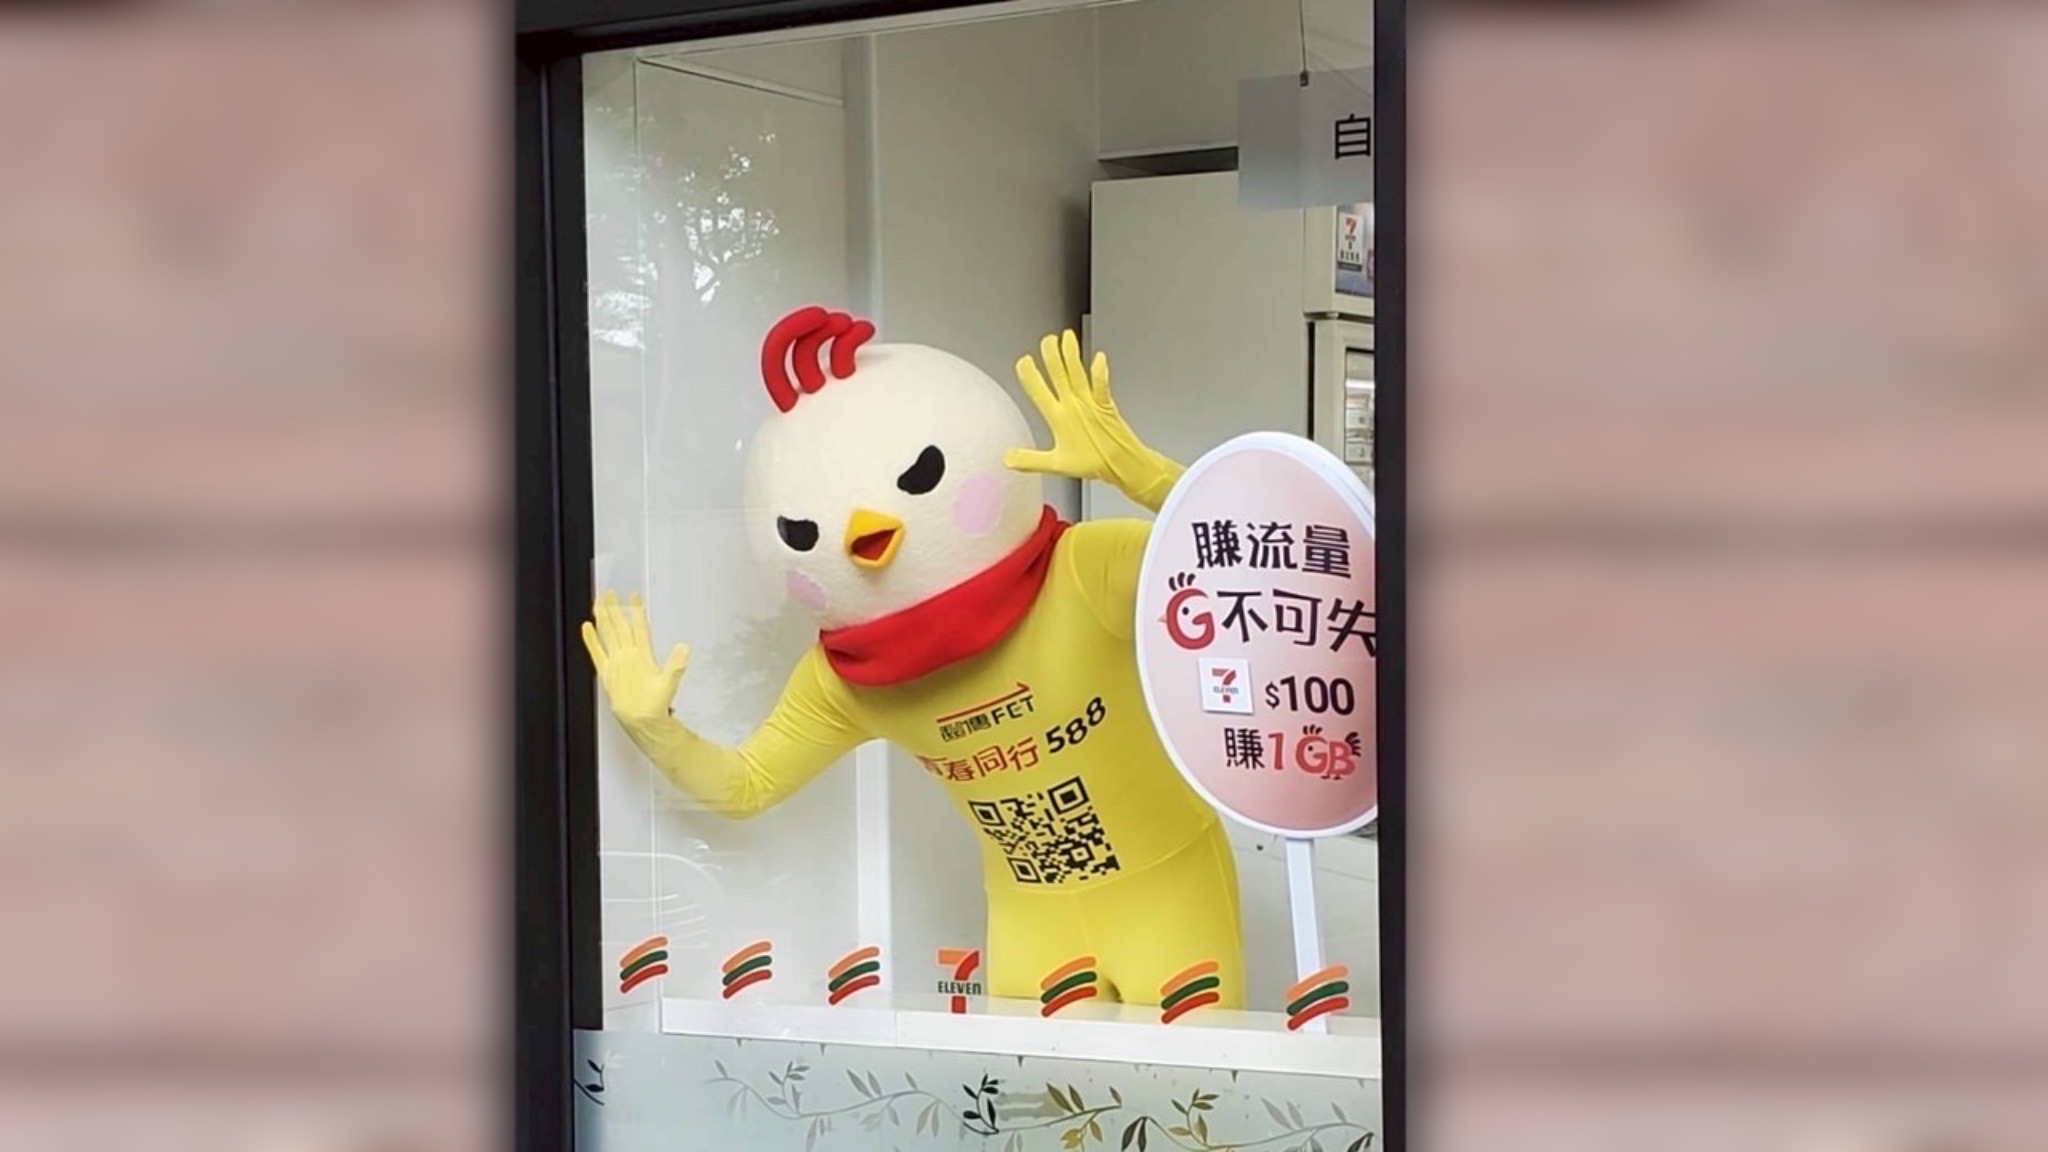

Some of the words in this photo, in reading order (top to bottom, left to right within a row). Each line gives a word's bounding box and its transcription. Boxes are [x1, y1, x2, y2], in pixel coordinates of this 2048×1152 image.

[1335, 113, 1371, 159] 自
[1192, 520, 1351, 579] 賺流量
[991, 695, 1034, 725] FET
[1265, 675, 1355, 716] $100
[1045, 697, 1106, 754] 588
[938, 949, 979, 1014] 7
